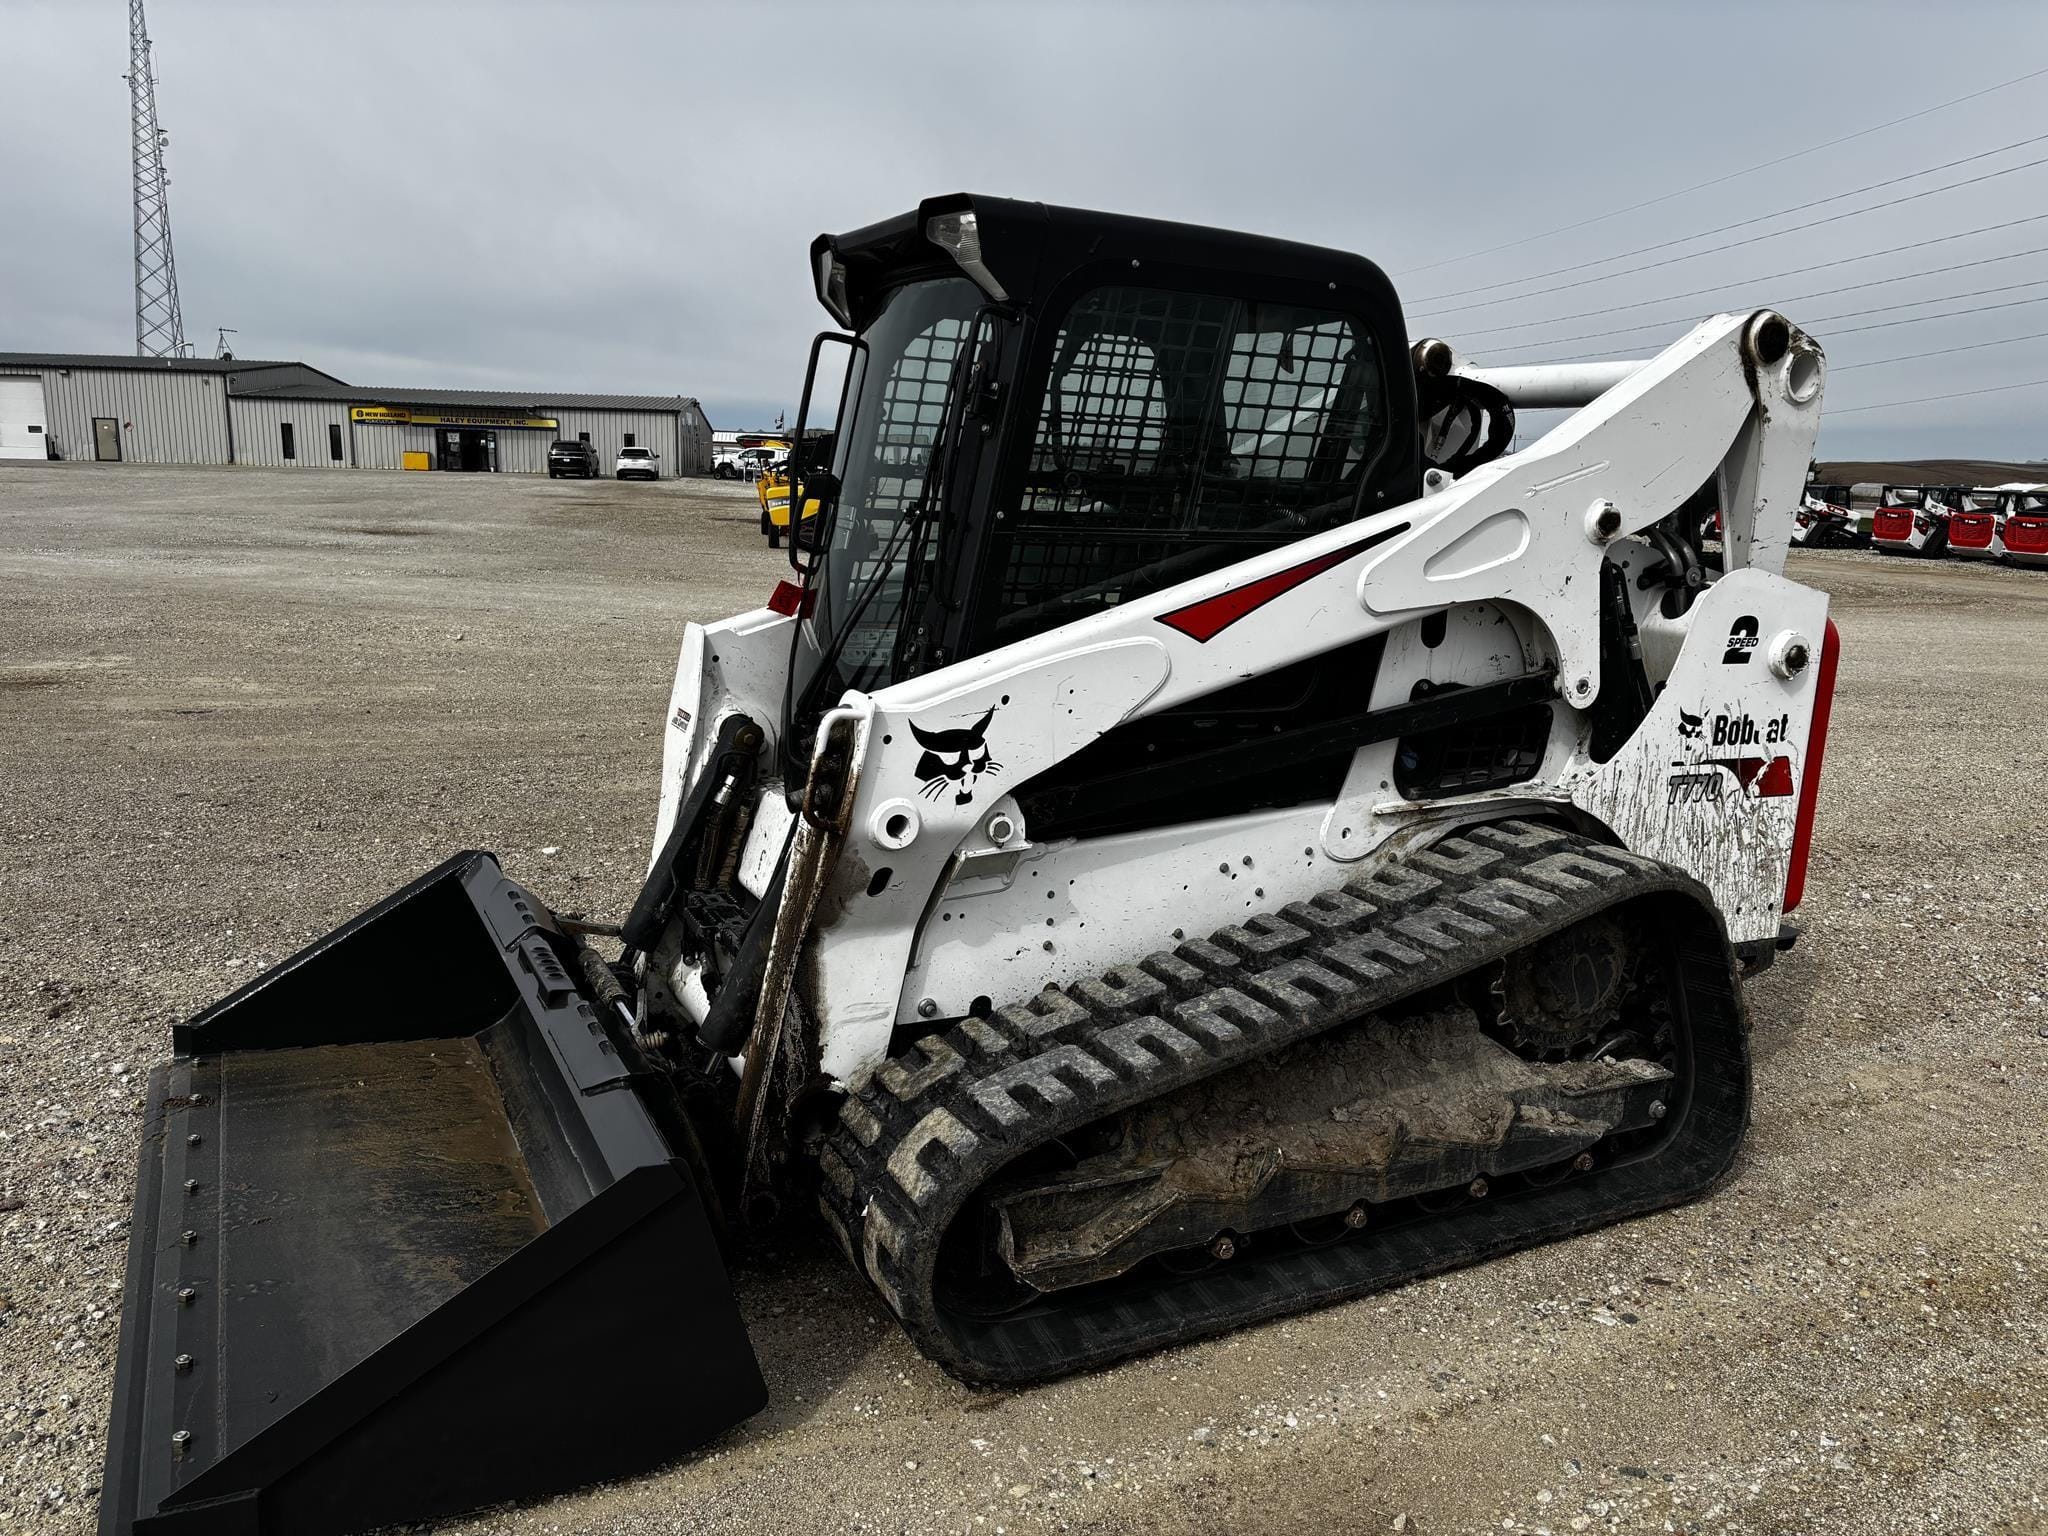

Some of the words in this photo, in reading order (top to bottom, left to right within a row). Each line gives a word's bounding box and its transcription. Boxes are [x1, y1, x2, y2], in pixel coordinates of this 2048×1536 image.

[466, 418, 512, 426] EQUIPMENT,
[1722, 615, 1759, 664] 2
[1727, 637, 1759, 648] SPEED
[1668, 772, 1723, 805] T770
